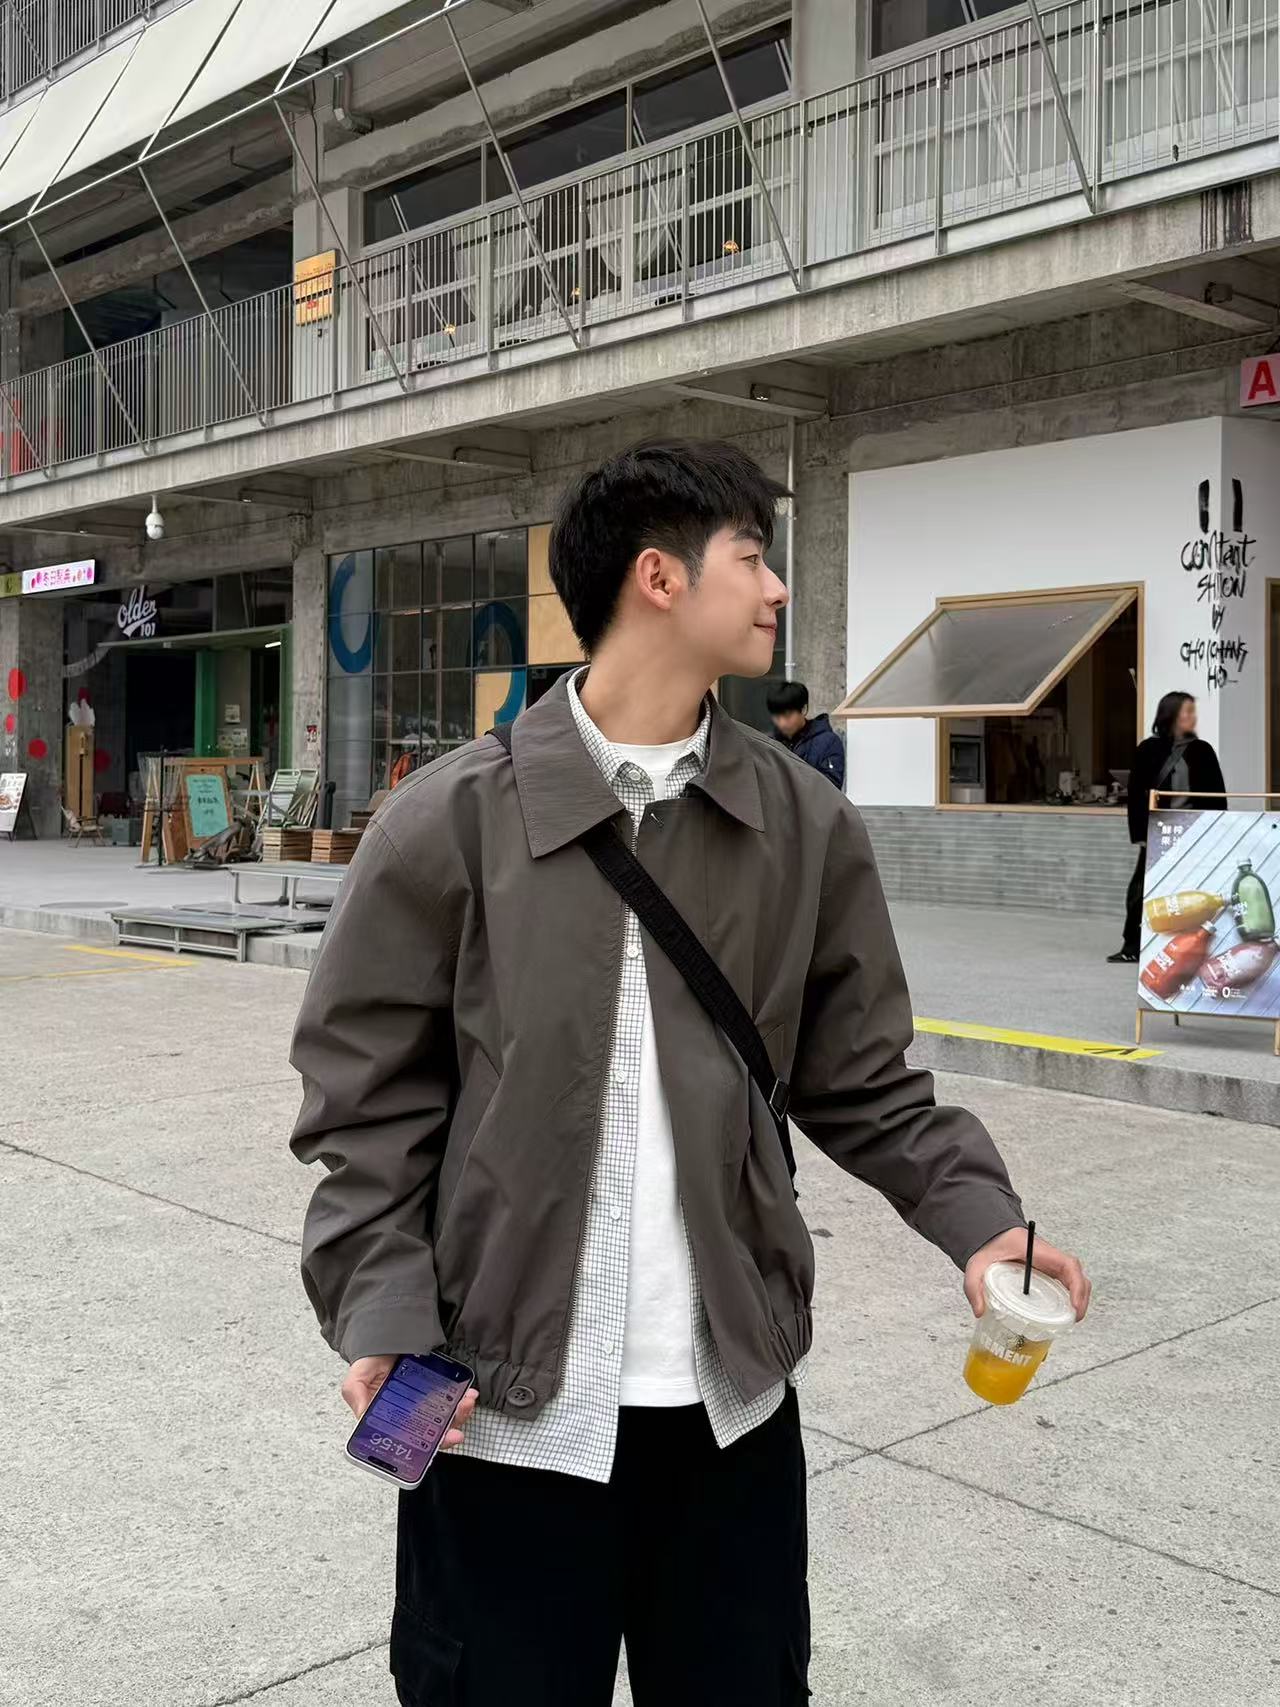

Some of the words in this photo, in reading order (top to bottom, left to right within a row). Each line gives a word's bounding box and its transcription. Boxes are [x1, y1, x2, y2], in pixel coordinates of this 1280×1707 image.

[1248, 360, 1277, 400] A
[141, 622, 156, 637] 101
[369, 1433, 412, 1460] 14:56
